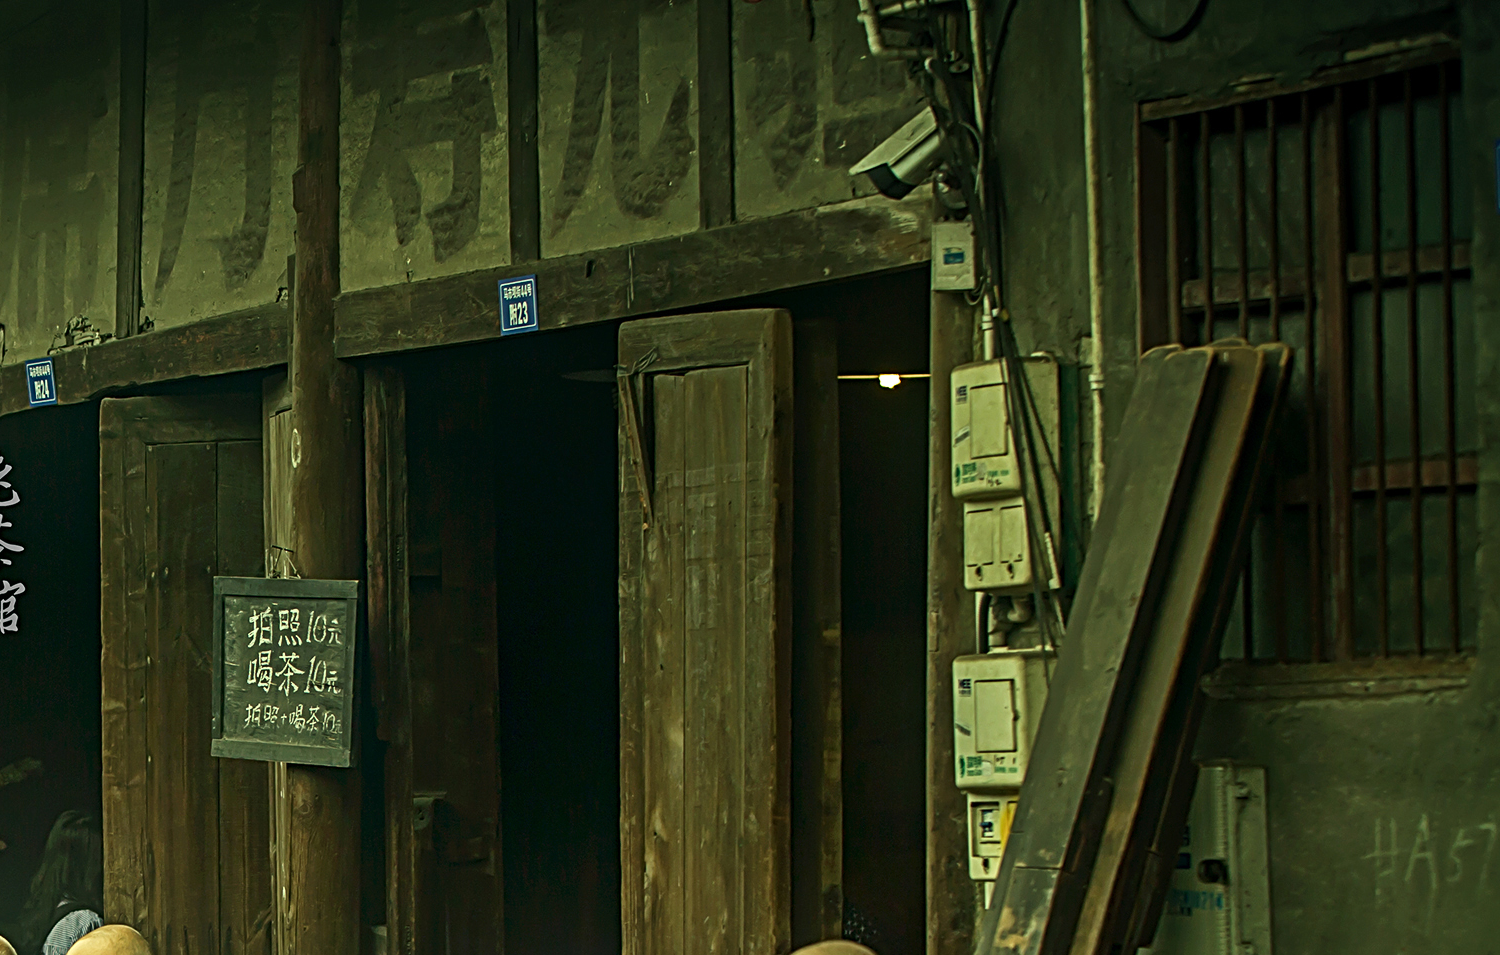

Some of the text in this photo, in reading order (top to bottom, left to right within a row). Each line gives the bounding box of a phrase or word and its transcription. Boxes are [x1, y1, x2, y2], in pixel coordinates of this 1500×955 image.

[247, 606, 342, 648] 拍照10元
[246, 650, 342, 697] 喝茶10元
